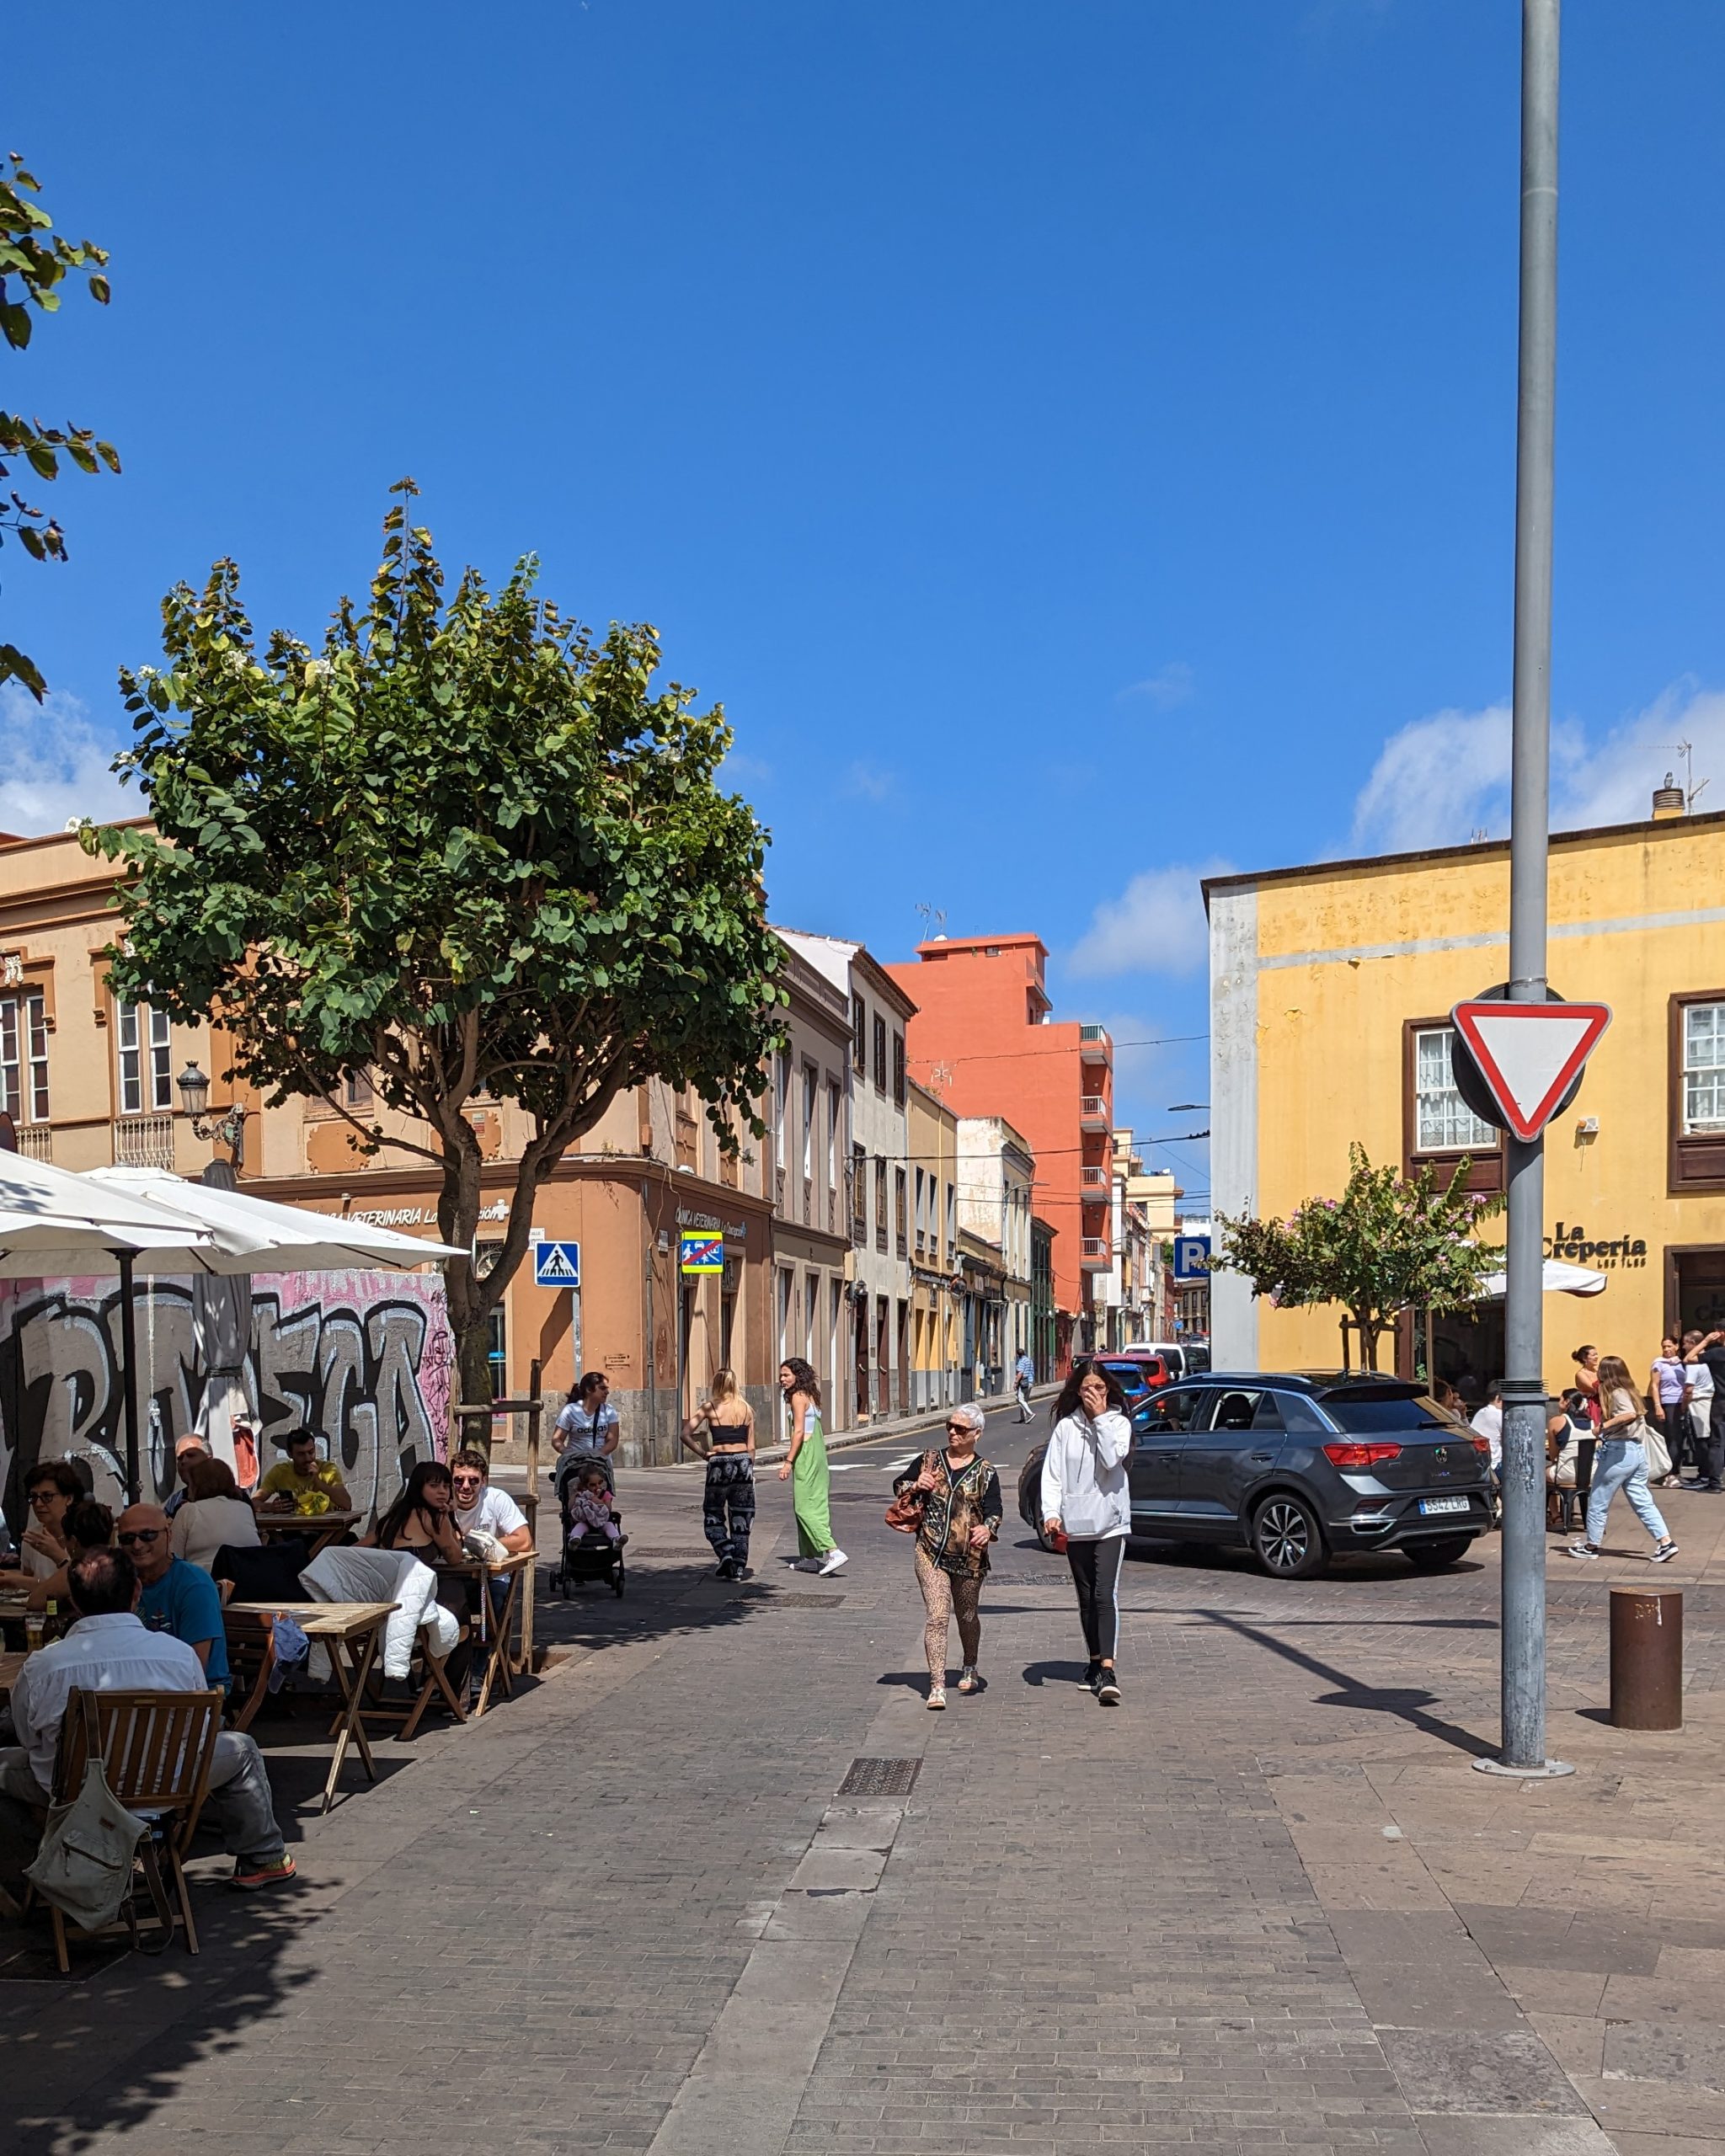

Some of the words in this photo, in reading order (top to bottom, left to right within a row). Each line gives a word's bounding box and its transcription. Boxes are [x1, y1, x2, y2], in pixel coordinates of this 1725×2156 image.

[1555, 1222, 1584, 1241] La
[1182, 1242, 1204, 1273] P
[1426, 1498, 1449, 1512] 5542
